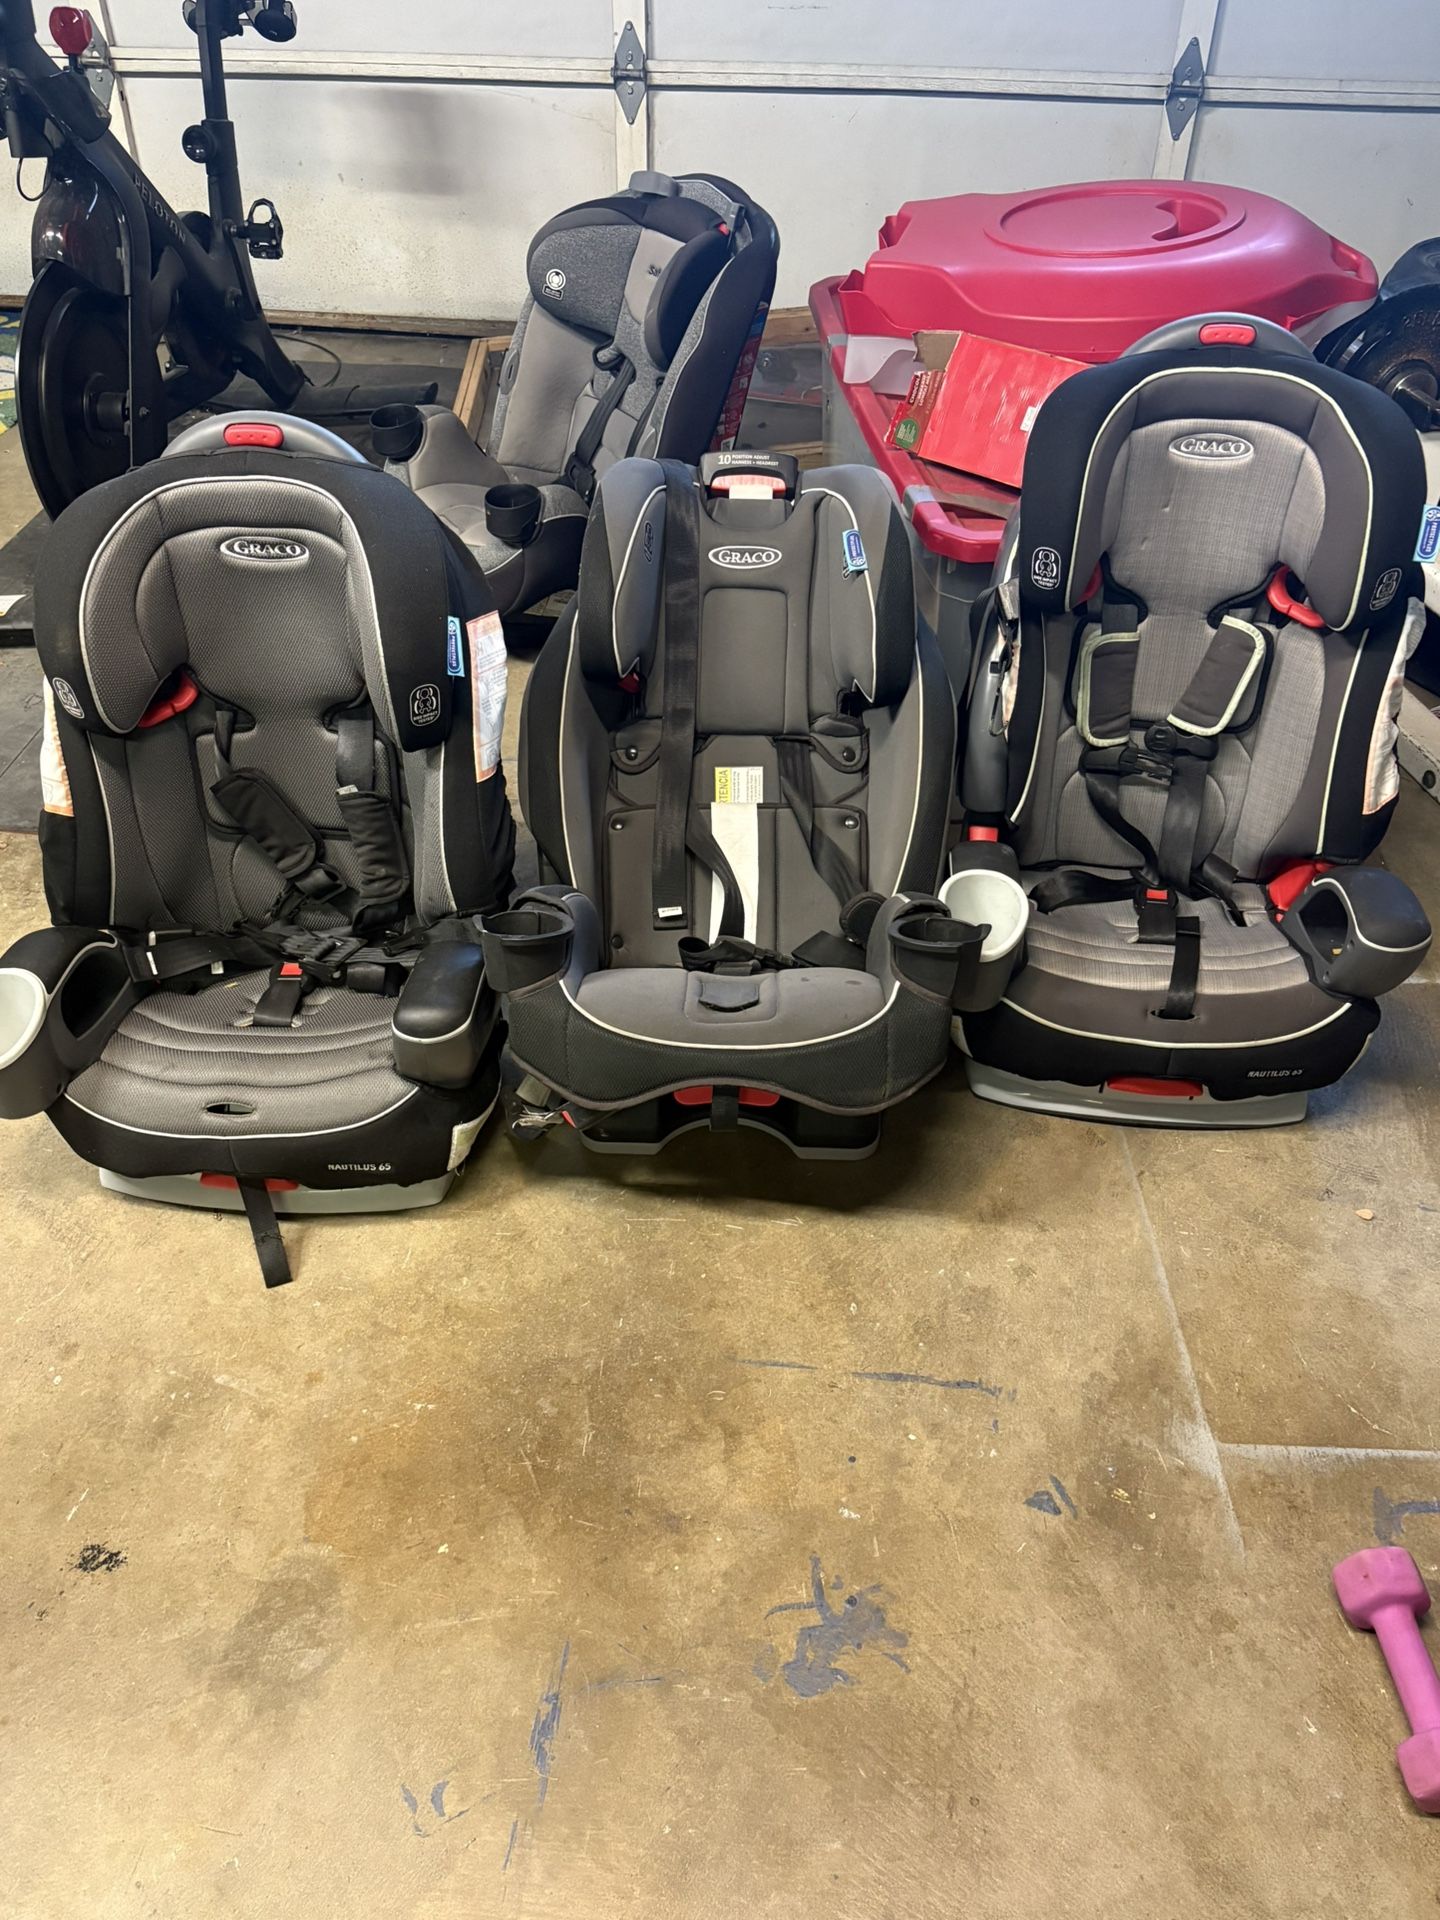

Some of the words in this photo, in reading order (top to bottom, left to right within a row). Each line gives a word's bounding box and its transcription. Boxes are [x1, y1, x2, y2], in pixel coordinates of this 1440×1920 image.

[134, 172, 186, 243] PELOTON
[1180, 438, 1246, 454] GRACO
[718, 454, 732, 465] 10
[233, 540, 301, 556] GRACO
[718, 550, 775, 564] GRACO
[328, 1163, 376, 1171] NAUTILUS
[378, 1163, 391, 1171] 65
